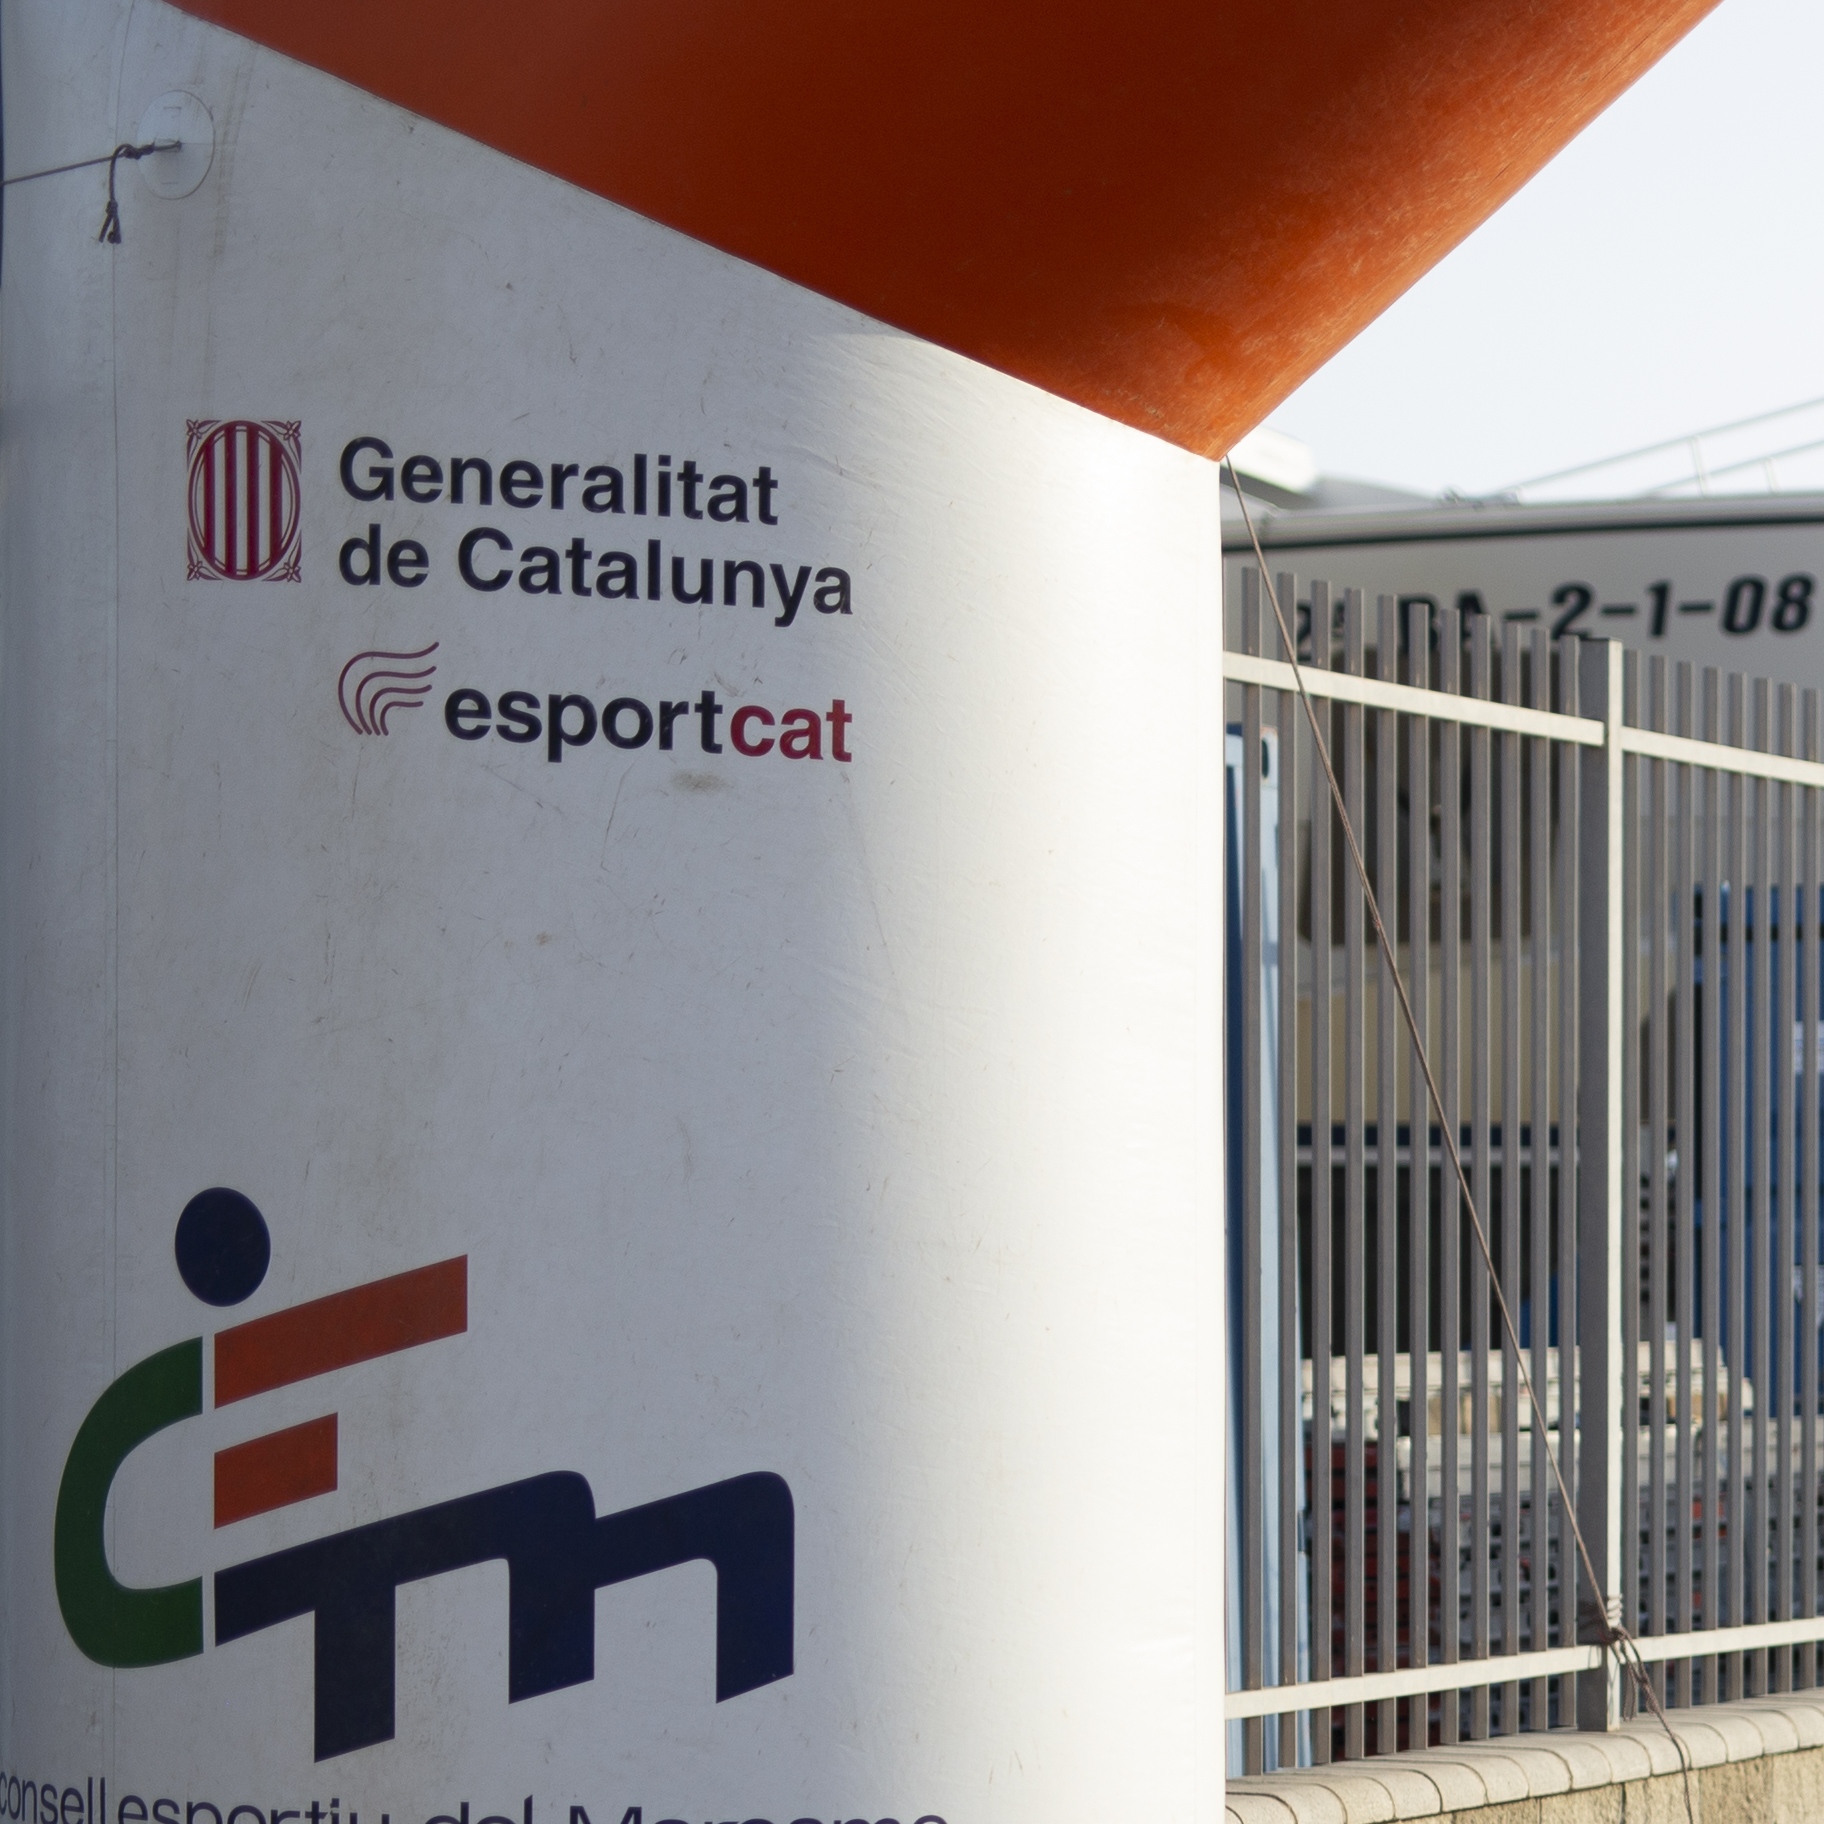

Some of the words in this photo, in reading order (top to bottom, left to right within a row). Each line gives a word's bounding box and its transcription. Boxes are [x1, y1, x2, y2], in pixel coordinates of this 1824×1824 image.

[339, 436, 779, 527] Generalitat
[338, 523, 429, 588] de
[458, 527, 853, 628] Catalunya
[444, 688, 853, 763] esportcat
